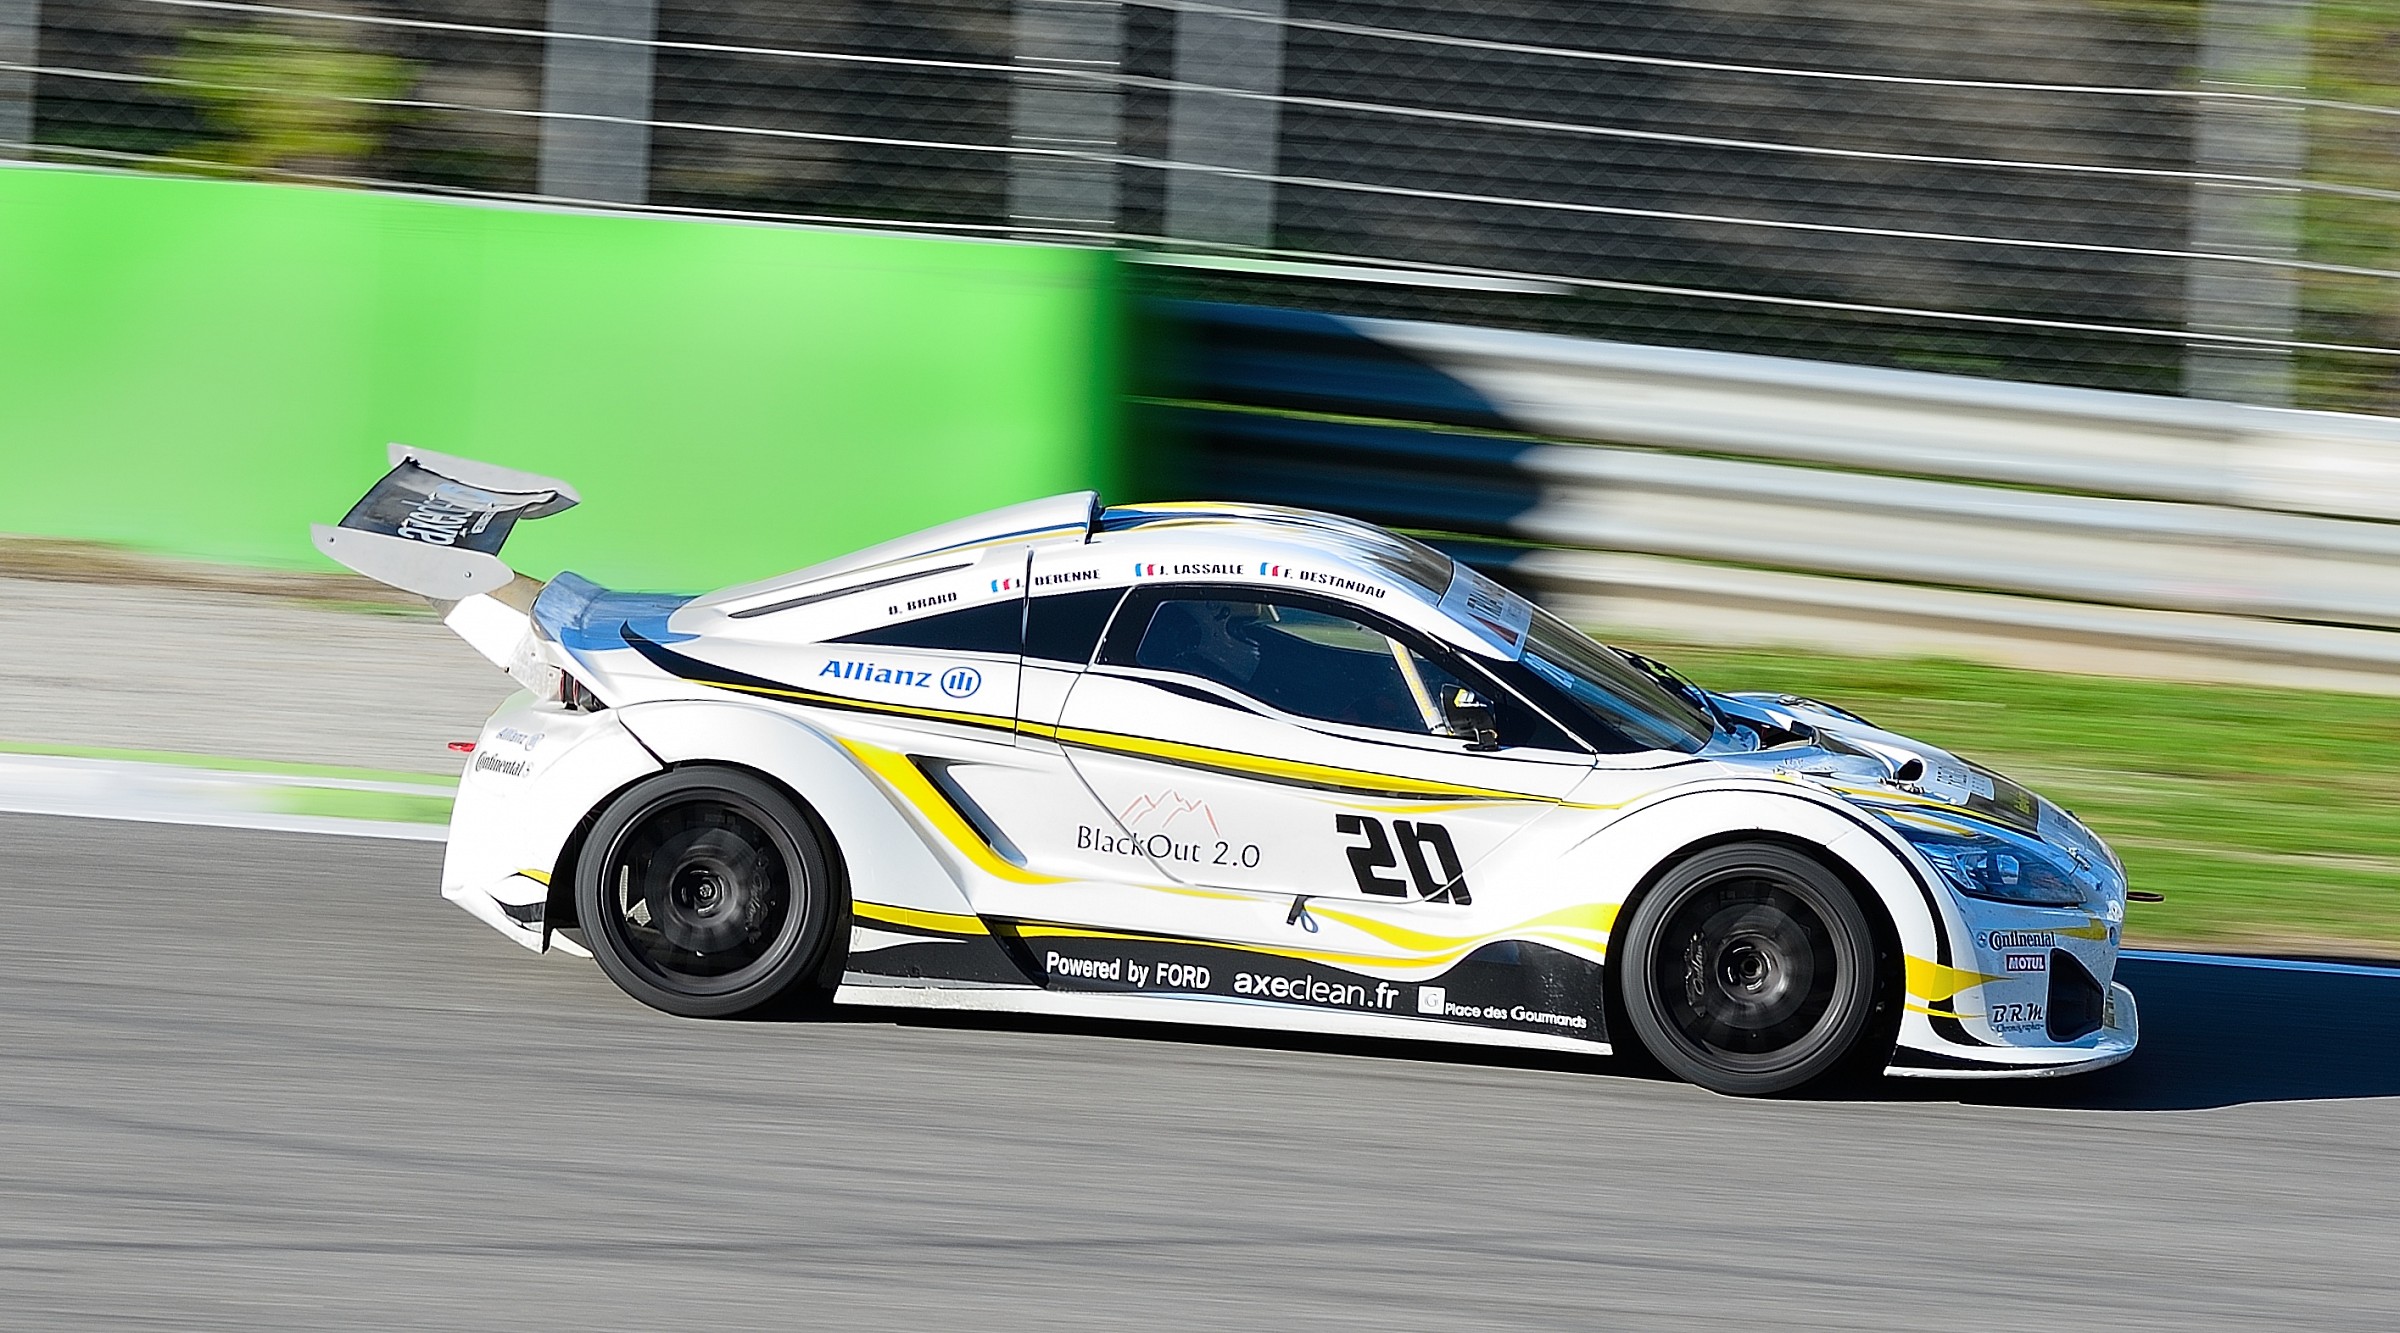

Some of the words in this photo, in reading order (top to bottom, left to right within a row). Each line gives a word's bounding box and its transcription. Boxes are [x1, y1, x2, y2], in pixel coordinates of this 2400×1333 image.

[1035, 569, 1101, 586] DERENNE
[1159, 565, 1169, 576] J.
[1174, 563, 1244, 575] LASSALLE
[1284, 568, 1293, 580] F.
[1299, 570, 1386, 599] DESTANDAU
[889, 606, 903, 616] D.
[907, 592, 957, 611] BRARD
[819, 660, 932, 688] Allianz
[475, 751, 526, 776] Continental
[1077, 825, 1202, 863] BlackOut
[1212, 841, 1260, 868] 2.0
[1335, 813, 1473, 905] 20
[1989, 930, 2055, 951] Continental
[1046, 951, 1121, 980] Powered
[1127, 960, 1150, 987] by
[1156, 963, 1211, 989] FORD
[2008, 957, 2045, 970] MOTUL
[1233, 972, 1399, 1009] axeclean.fr
[1445, 1002, 1481, 1018] Place
[1483, 1003, 1508, 1019] des
[1511, 1005, 1587, 1029] Gourmands
